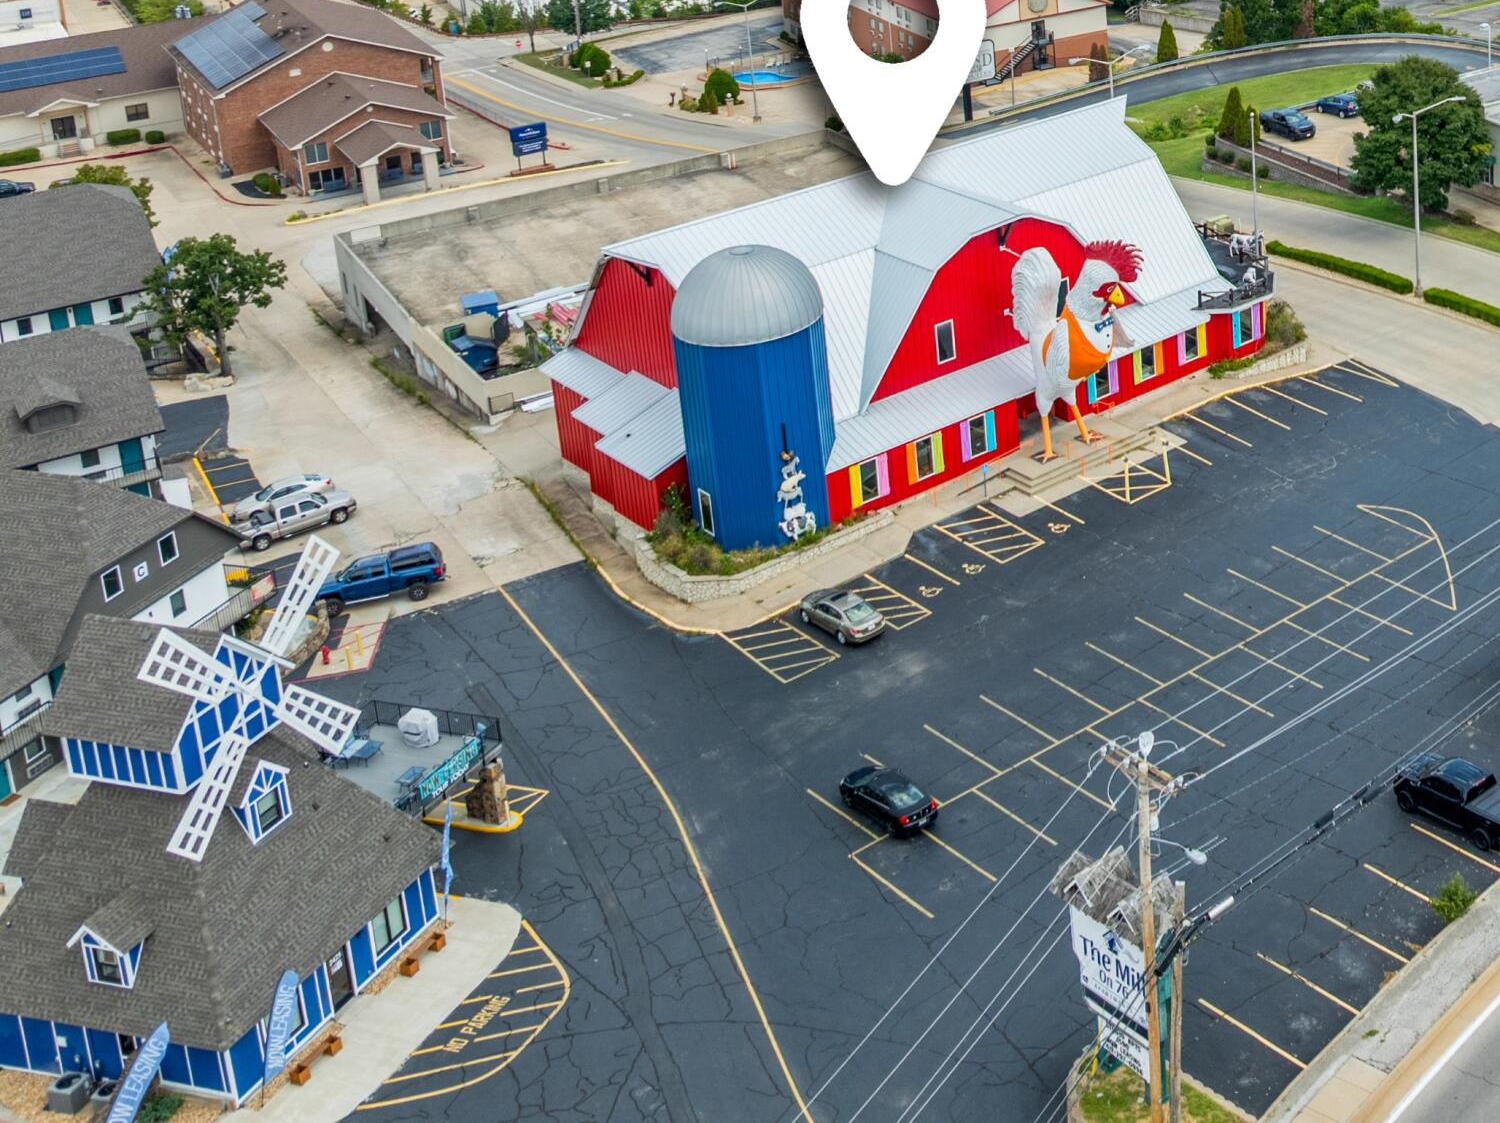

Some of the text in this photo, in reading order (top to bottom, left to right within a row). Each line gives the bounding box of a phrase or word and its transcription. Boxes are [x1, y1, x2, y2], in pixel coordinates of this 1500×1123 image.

[1080, 934, 1111, 972] The
[1099, 969, 1129, 998] On 76
[267, 984, 298, 1069] NOW LEASING
[443, 995, 511, 1053] NO PARKING
[120, 1037, 165, 1102] LEASING
